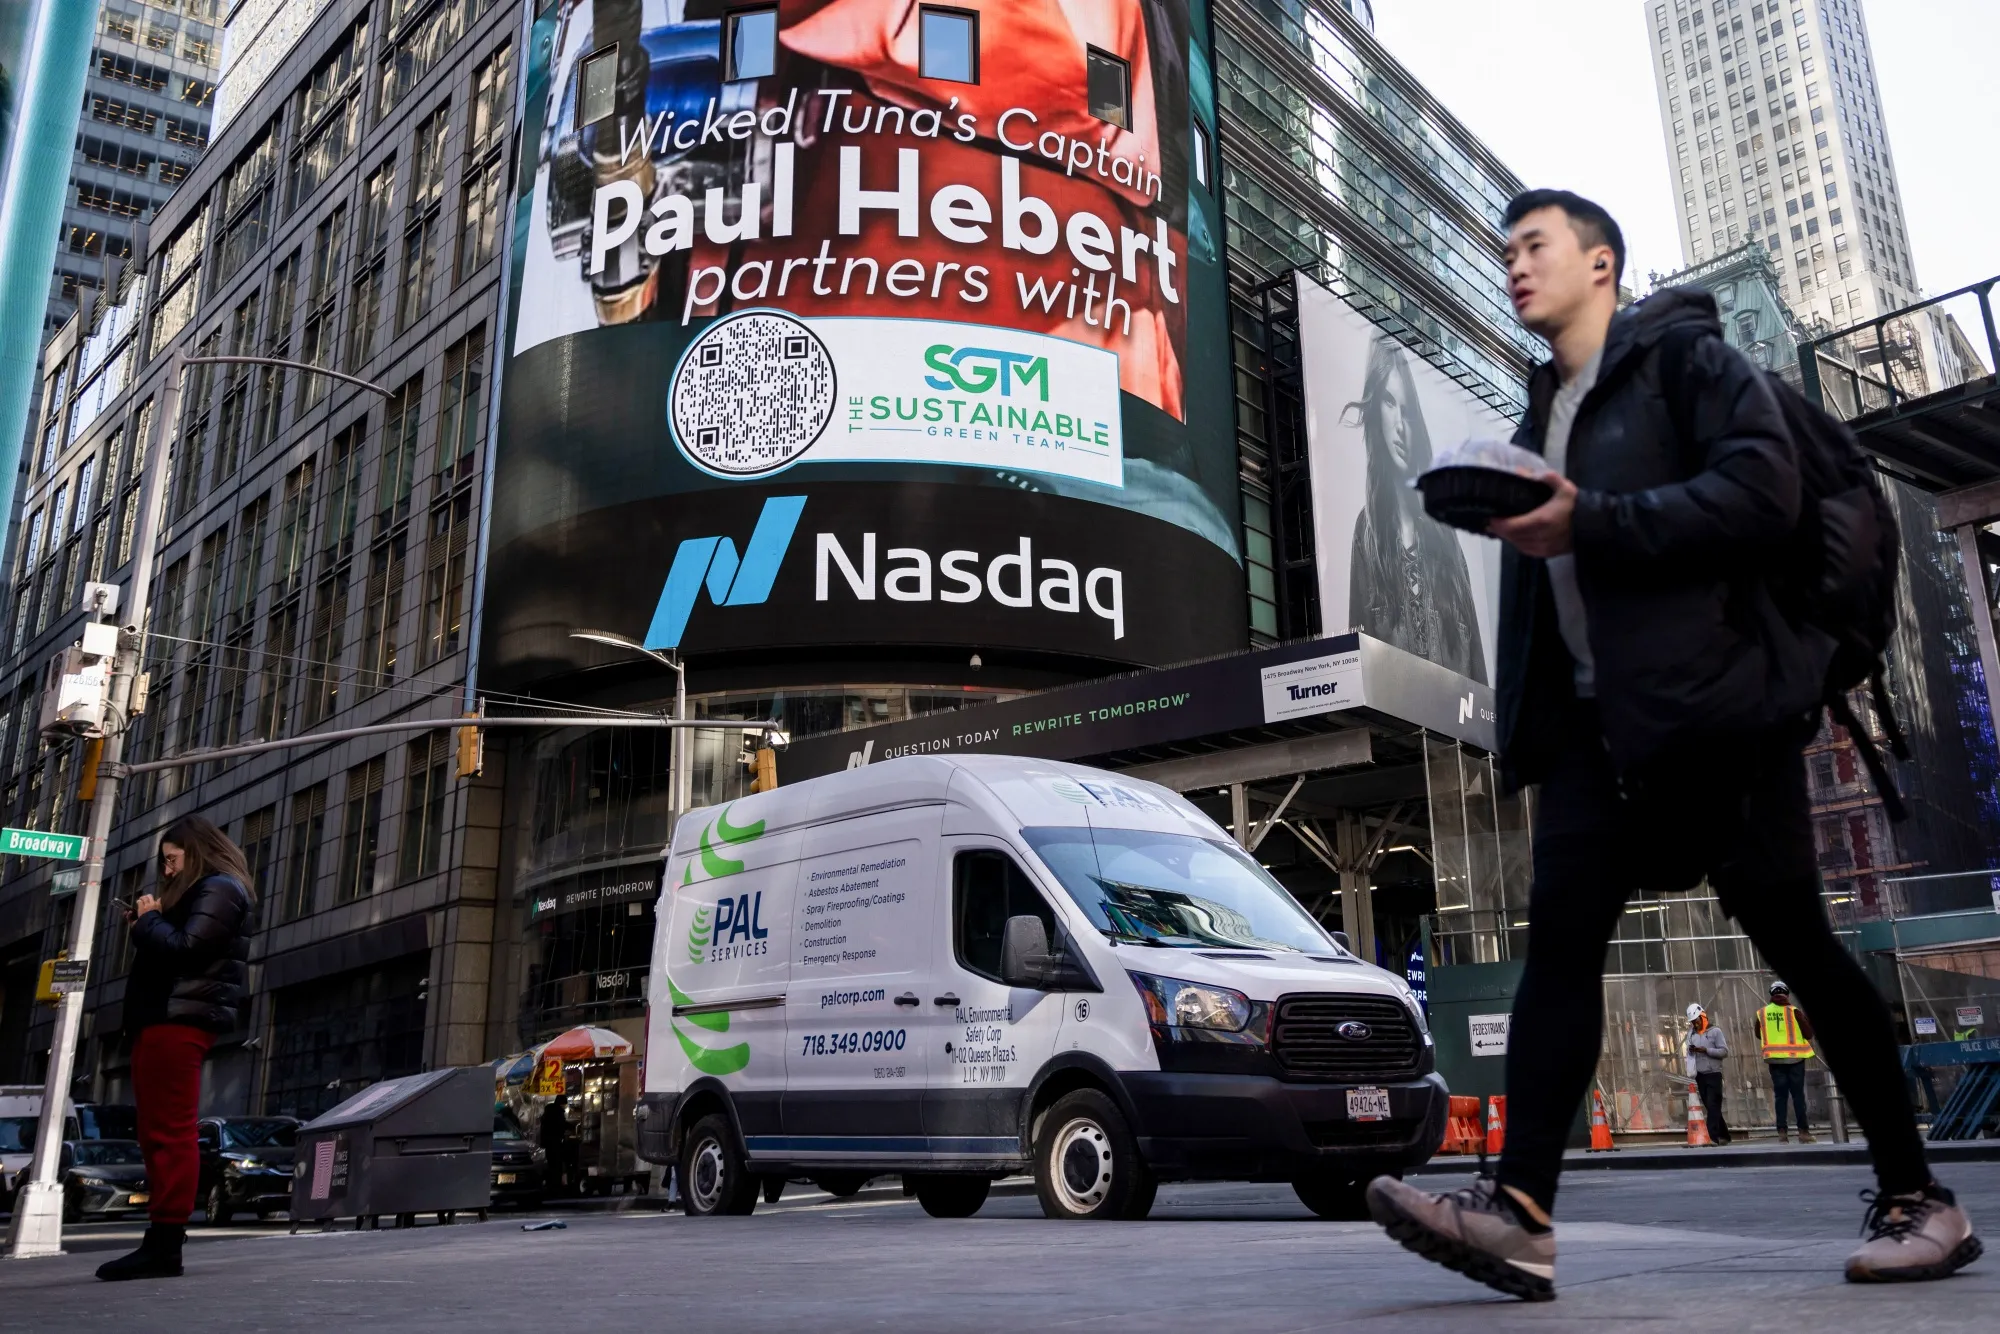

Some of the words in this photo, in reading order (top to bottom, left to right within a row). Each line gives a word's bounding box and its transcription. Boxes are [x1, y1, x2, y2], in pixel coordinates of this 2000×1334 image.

[618, 89, 795, 167] Wicked
[815, 88, 977, 142] Tuna's
[997, 108, 1164, 203] Captain
[590, 142, 795, 276] Paul
[838, 146, 1181, 305] Hebert
[682, 239, 989, 325] partners
[1016, 269, 1133, 336] with
[924, 344, 1049, 402] SGTM
[849, 396, 863, 433] THE
[869, 396, 1110, 447] SUSTAINABLE
[927, 426, 998, 442] GREEN
[1012, 433, 1066, 452] TEAM
[815, 532, 1124, 640] Nasdaq
[1263, 671, 1277, 680] 1475
[1277, 667, 1304, 678] Broadway
[1305, 663, 1318, 672] New
[1318, 661, 1332, 669] York,
[1342, 656, 1359, 665] 10036
[1286, 681, 1338, 701] Turner
[1012, 713, 1082, 736] REWRITE
[884, 738, 951, 759] QUESTION
[956, 728, 1000, 747] TODAY
[9, 832, 73, 858] Broadway
[811, 864, 860, 881] Environmental
[860, 857, 906, 873] Remediation
[538, 897, 556, 912] Nasdaq
[566, 888, 598, 904] REWRITE
[601, 880, 654, 897] TOMORROW
[808, 885, 839, 898] Asbestos
[840, 878, 879, 893] Abatement
[806, 904, 826, 916] Spray
[826, 891, 906, 911] Fireproofing/Coatings
[713, 891, 768, 946] PAL
[805, 918, 842, 931] Demolition
[711, 941, 767, 963] SERVICES
[804, 934, 847, 948] Construction
[803, 952, 841, 966] Emergency
[842, 948, 877, 962] Response
[597, 970, 630, 989] Nasdaq
[821, 989, 885, 1009] palcorp.com
[955, 1007, 969, 1024] PAL
[969, 1003, 1014, 1024] Environmental
[1077, 1003, 1087, 1019] 16
[965, 1027, 986, 1045] Safety
[986, 1025, 1002, 1043] Corp
[1348, 1025, 1367, 1037] Ford
[1471, 1021, 1506, 1036] PEDESTRIANS
[802, 1029, 906, 1056] 718.349.0900
[1960, 1041, 1983, 1052] POLICE
[968, 1047, 992, 1064] Queens
[992, 1046, 1010, 1062] Plaza
[1010, 1045, 1018, 1062] S.
[874, 1067, 886, 1078] DEC
[979, 1066, 990, 1083] NY
[990, 1065, 1006, 1082] 11101
